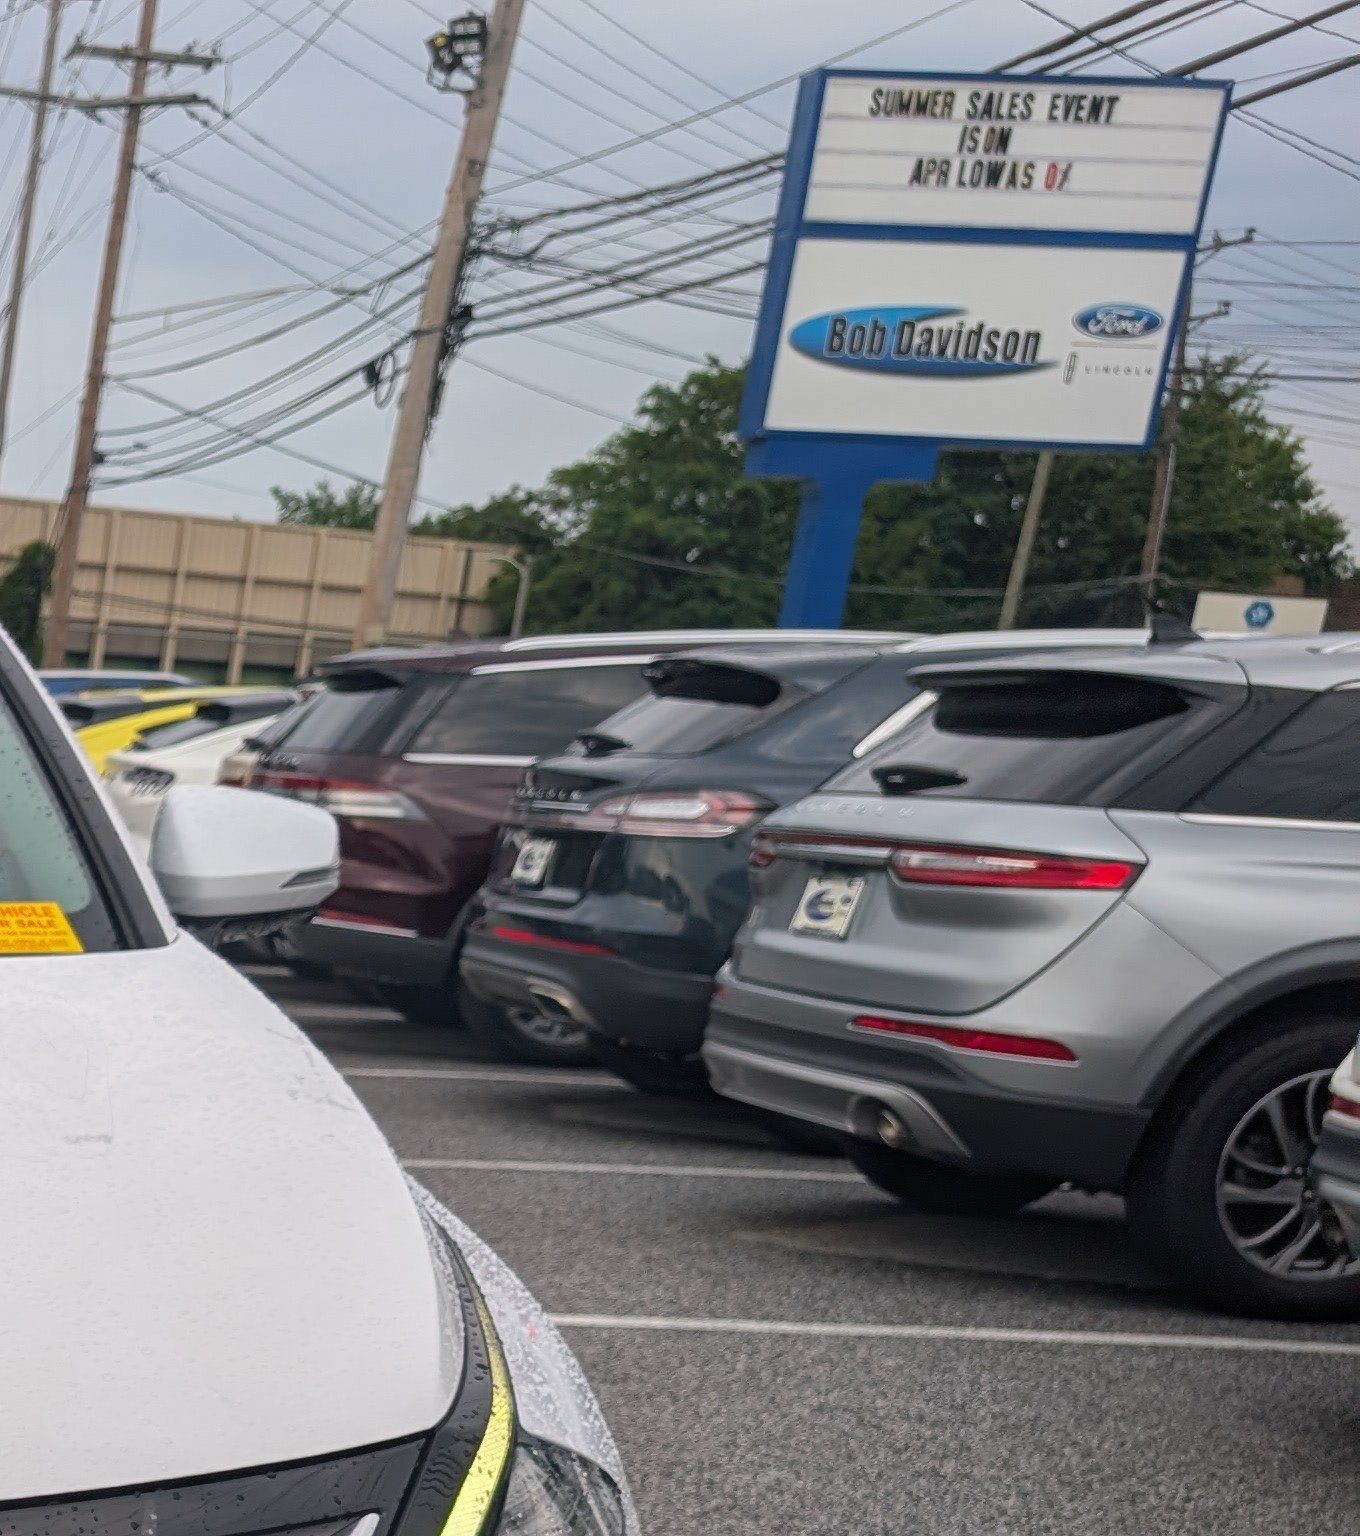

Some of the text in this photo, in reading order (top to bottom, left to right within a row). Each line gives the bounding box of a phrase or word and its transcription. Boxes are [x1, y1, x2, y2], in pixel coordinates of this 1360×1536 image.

[868, 87, 1119, 123] SUMMER SALES EVENT
[909, 158, 952, 187] APR
[1088, 308, 1150, 336] Ford
[826, 316, 1041, 364] Bob Davidson
[15, 919, 57, 928] SALE
